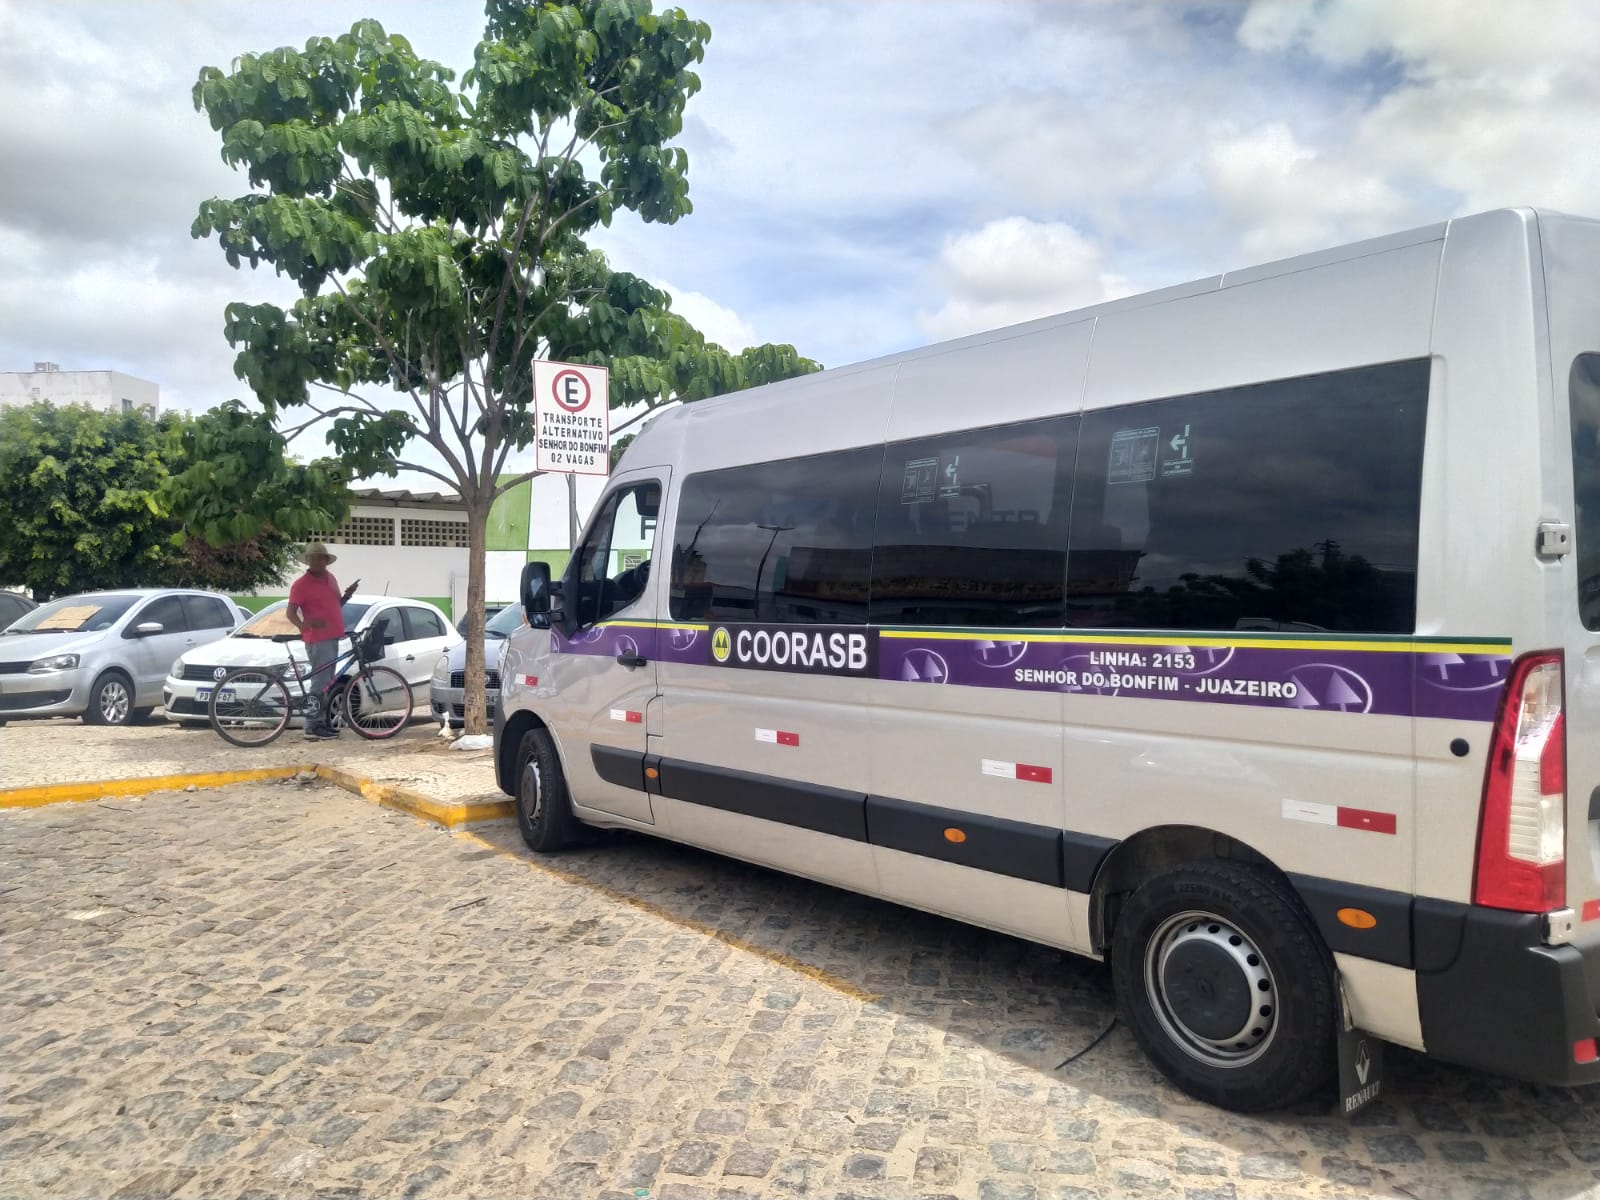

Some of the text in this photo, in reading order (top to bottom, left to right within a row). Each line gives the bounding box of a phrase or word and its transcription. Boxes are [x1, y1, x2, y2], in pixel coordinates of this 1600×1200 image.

[565, 377, 579, 404] E
[543, 412, 602, 428] TRANSPORTE
[542, 426, 603, 441] ALTERNATIVO
[539, 438, 607, 454] SENHOR DO BONFIM
[551, 452, 594, 466] 02 VAGAS
[737, 629, 868, 670] COORASB
[1089, 651, 1195, 669] LINHA: 2153
[1014, 668, 1077, 686] SENHOR
[1082, 672, 1105, 687] DO
[1110, 673, 1179, 692] BONFIM
[1195, 678, 1298, 699] JUAZEIRO
[1345, 1080, 1382, 1112] RENAULT
